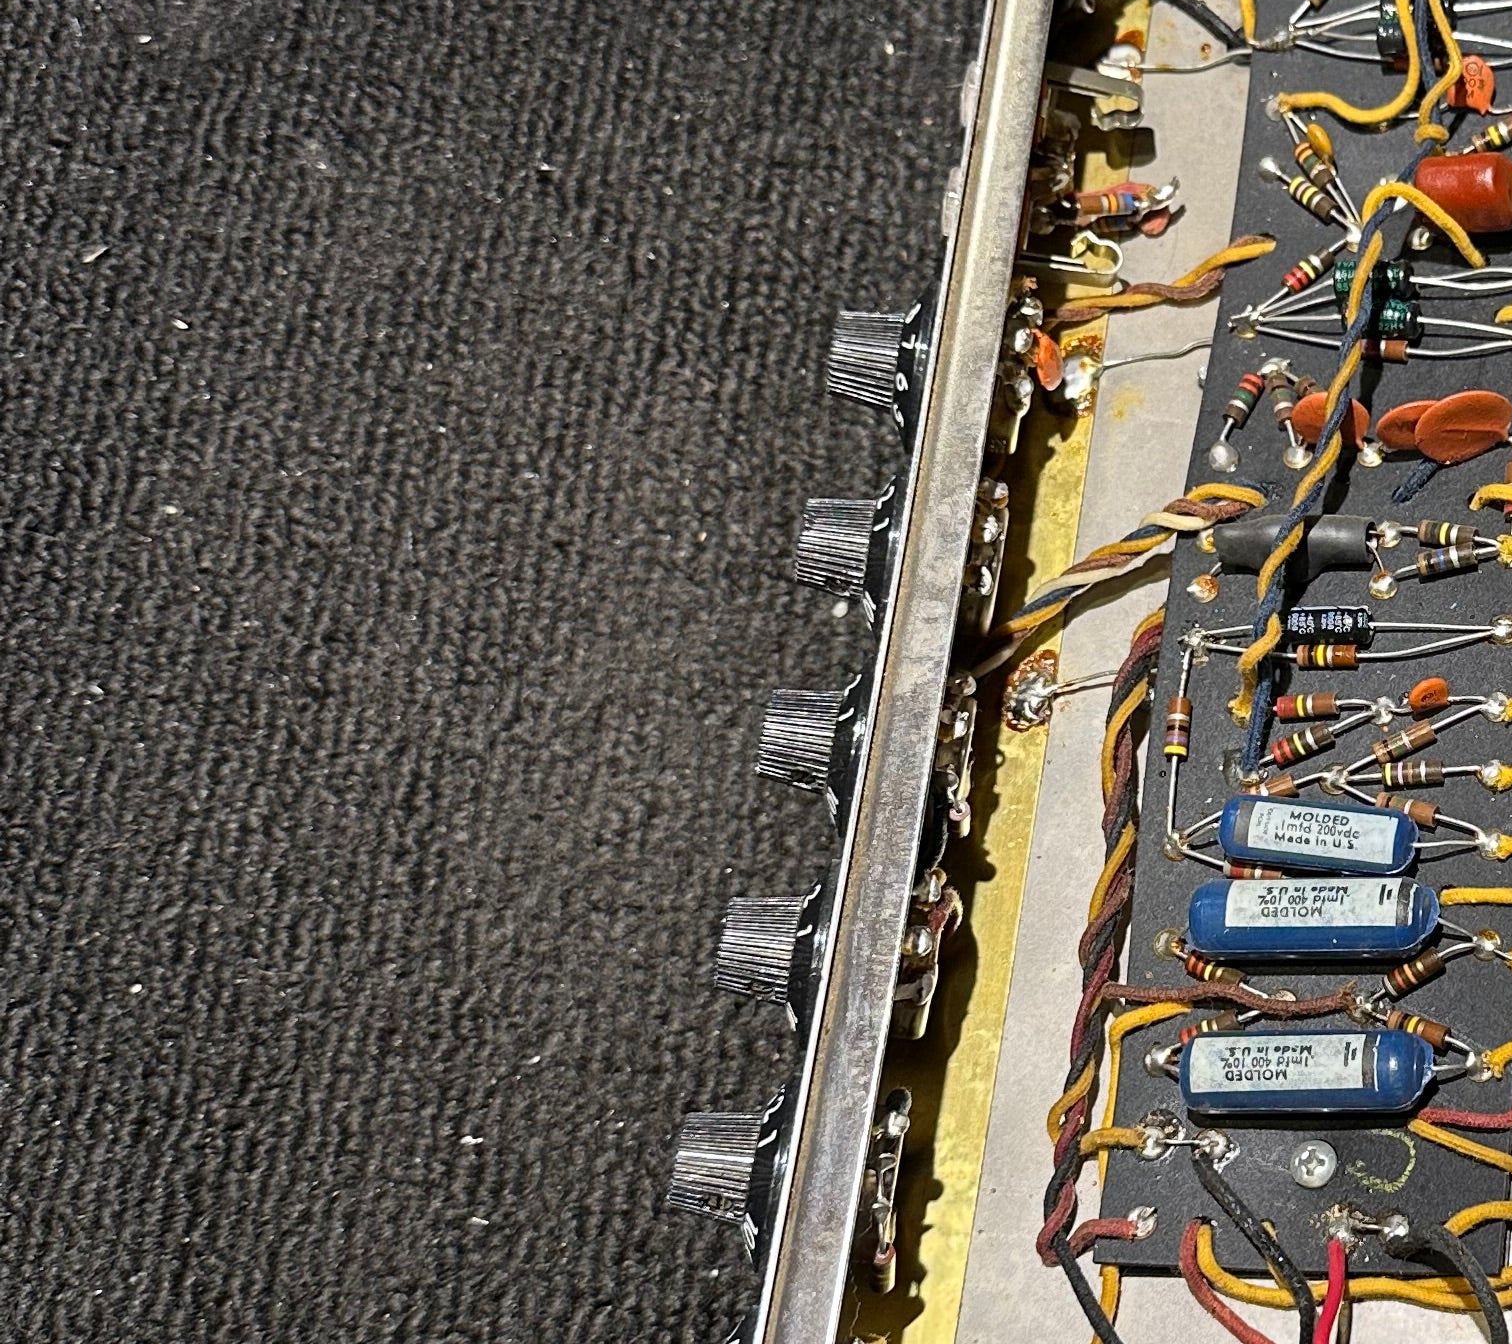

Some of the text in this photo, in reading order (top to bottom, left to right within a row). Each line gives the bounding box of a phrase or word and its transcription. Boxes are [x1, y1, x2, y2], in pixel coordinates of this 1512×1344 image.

[895, 372, 909, 391] 6
[1289, 810, 1350, 827] MOLDED
[1316, 824, 1361, 840] 200vdc
[1274, 831, 1310, 844] Made
[1315, 834, 1327, 847] in
[1293, 886, 1307, 895] in
[1311, 885, 1349, 895] Made
[1257, 894, 1281, 906] 10%
[1288, 894, 1308, 905] 400
[1261, 906, 1323, 918] MOLDED
[1256, 1045, 1270, 1055] in
[1273, 1045, 1313, 1056] Made
[1221, 1056, 1245, 1069] 10%
[1250, 1056, 1271, 1067] 400
[1224, 1068, 1288, 1082] MOLDED
